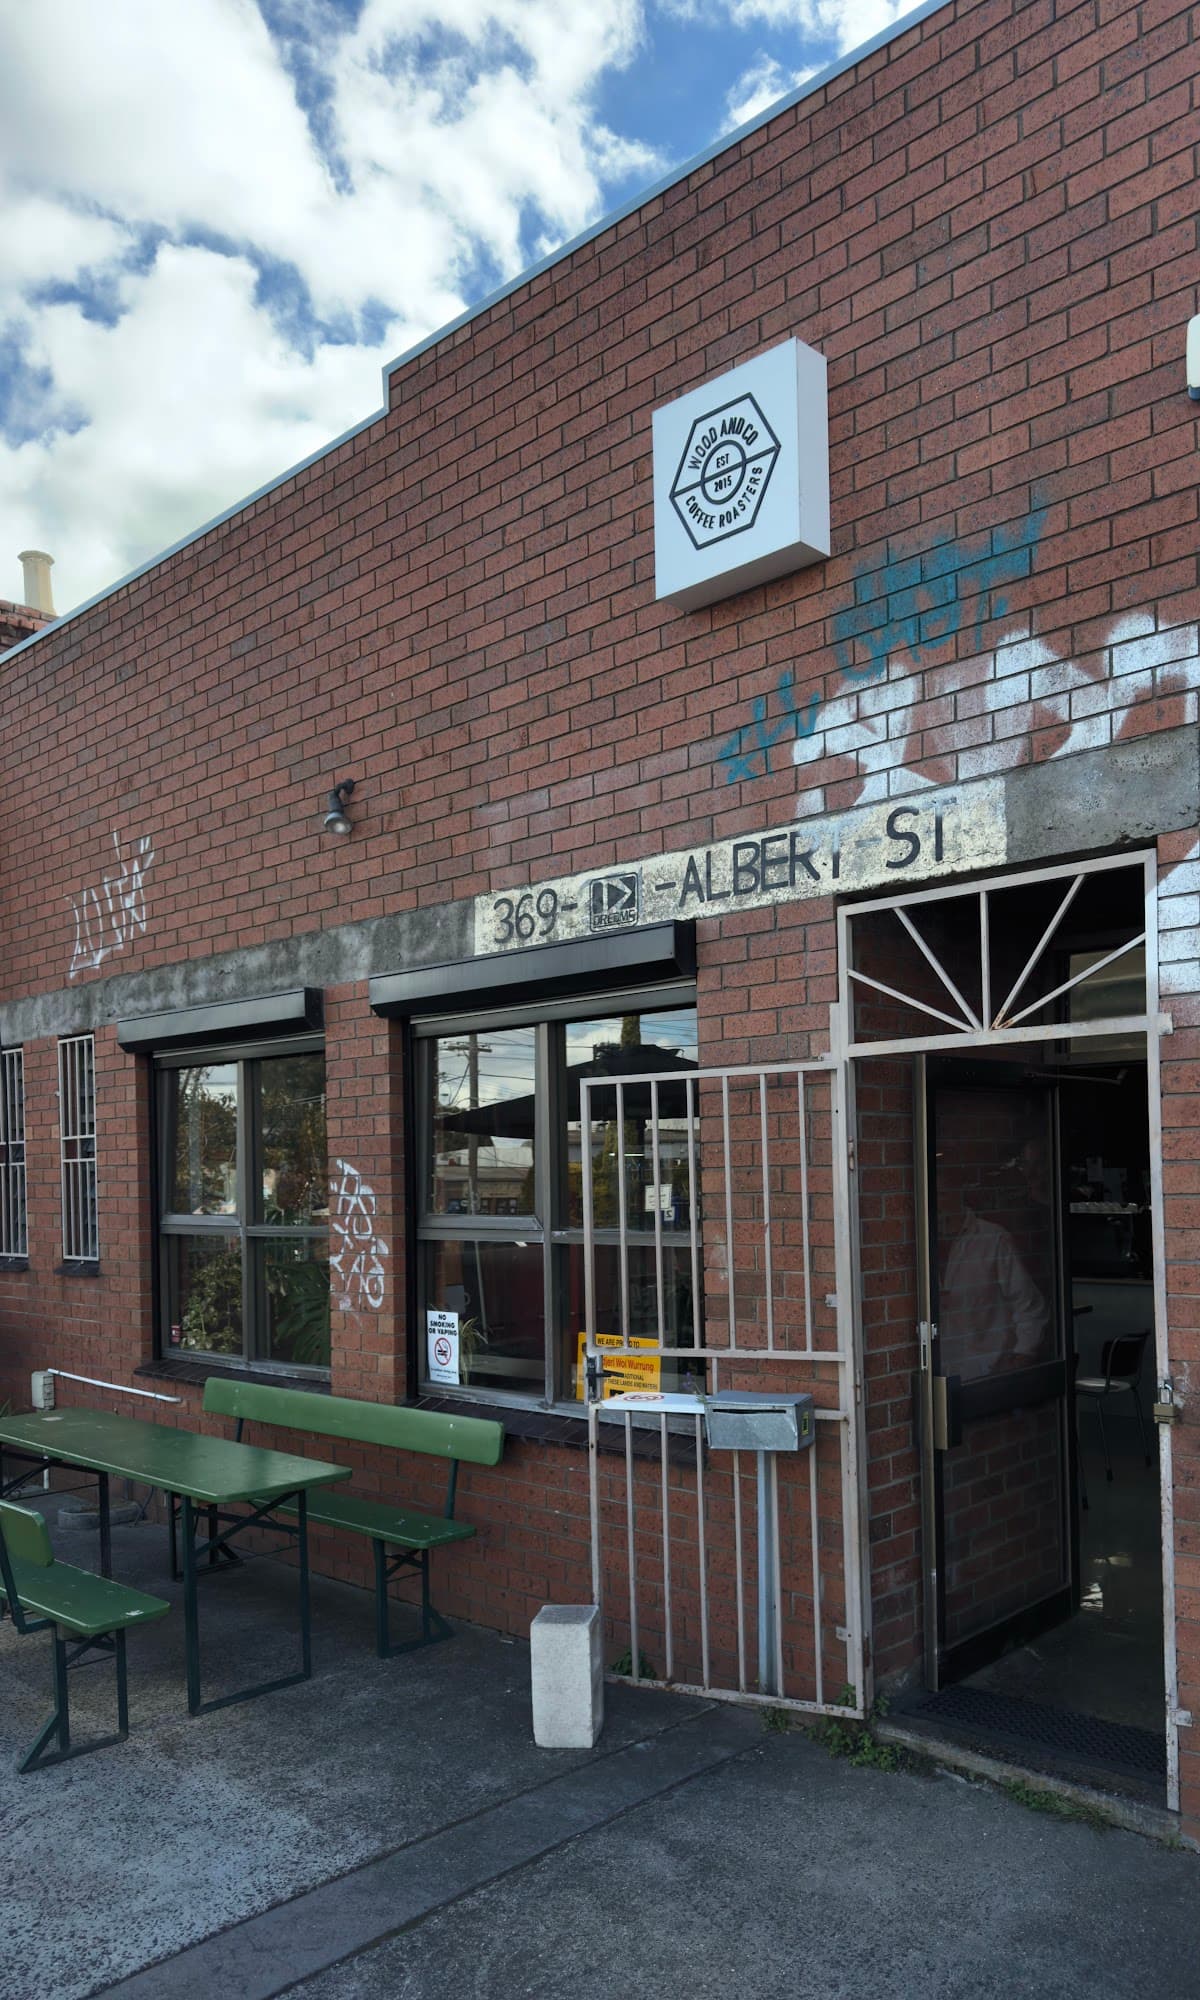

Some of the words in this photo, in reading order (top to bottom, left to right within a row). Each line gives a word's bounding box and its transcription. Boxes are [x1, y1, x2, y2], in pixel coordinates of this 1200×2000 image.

[687, 426, 718, 470] WOOD
[716, 453, 730, 469] EST
[714, 475, 732, 493] 2015
[686, 495, 716, 529] COFFEE
[719, 467, 763, 529] ROASTERS
[430, 1320, 455, 1329] SMOKING
[437, 1328, 457, 1336] VAPING
